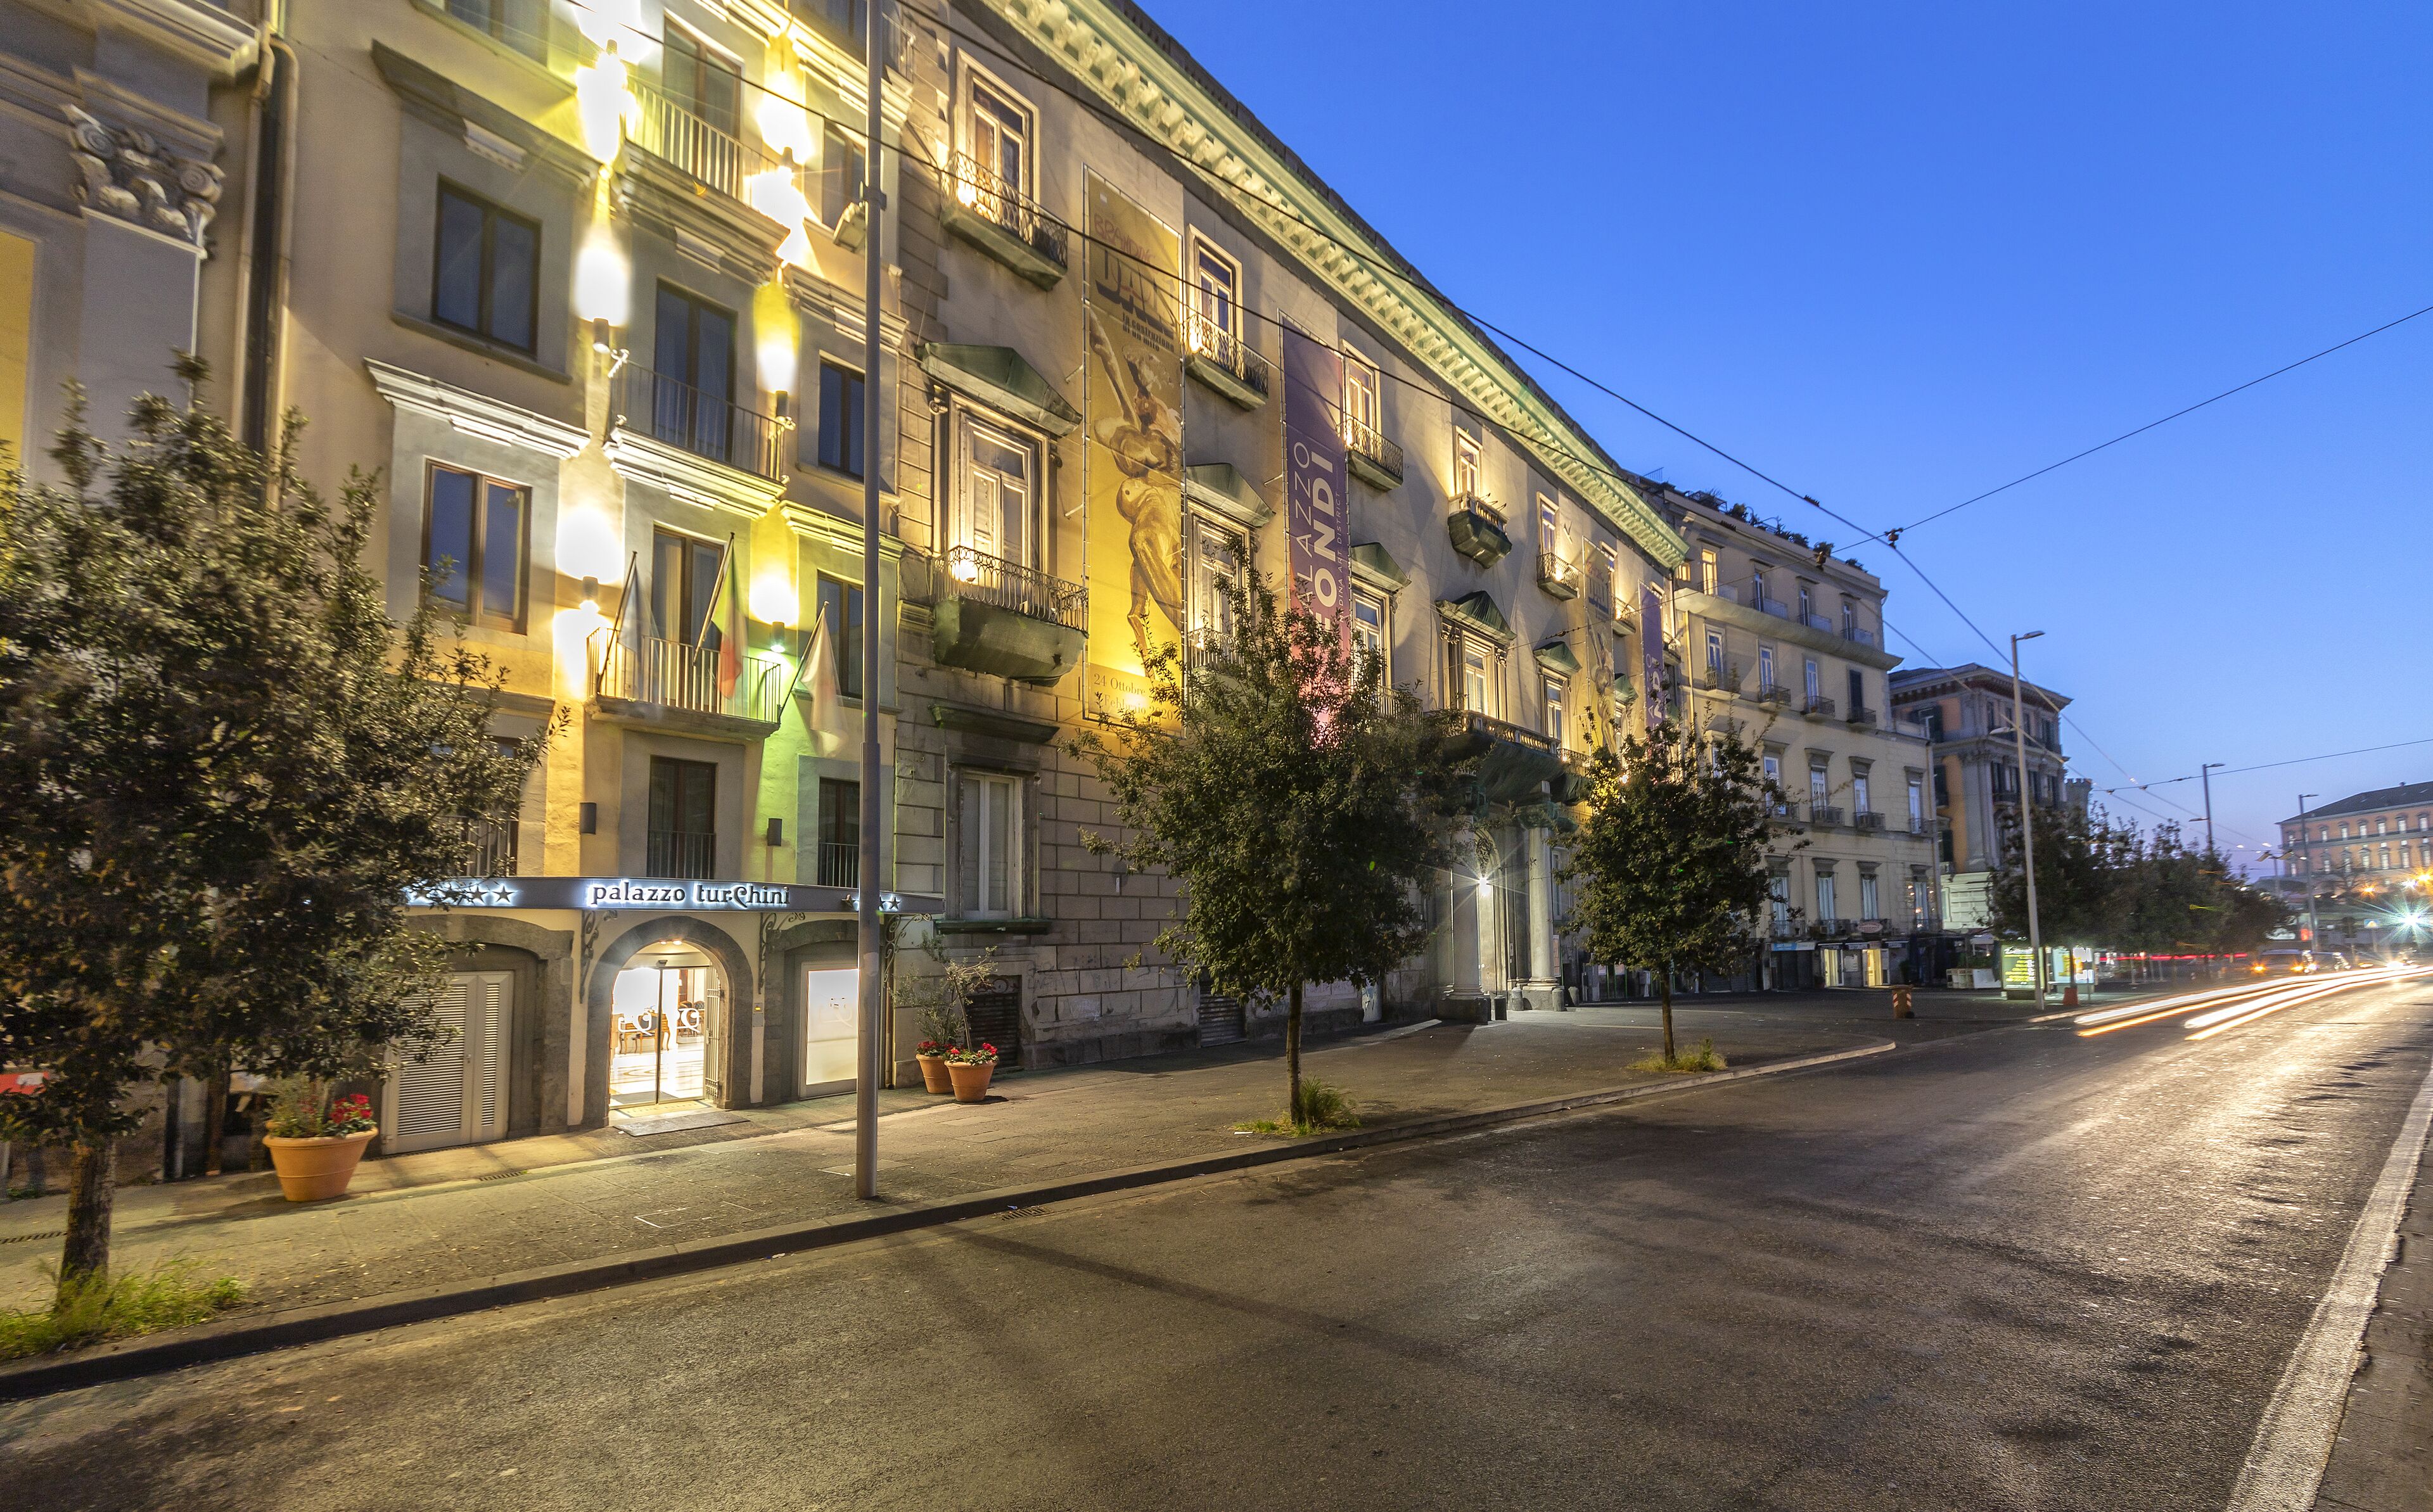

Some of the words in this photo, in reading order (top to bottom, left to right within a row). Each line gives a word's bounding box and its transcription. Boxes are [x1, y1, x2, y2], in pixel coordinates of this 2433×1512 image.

[1294, 442, 1313, 616] ALAZZO
[1094, 673, 1106, 687] 24
[1110, 677, 1146, 695] Ottobre
[591, 880, 686, 905] palazzo
